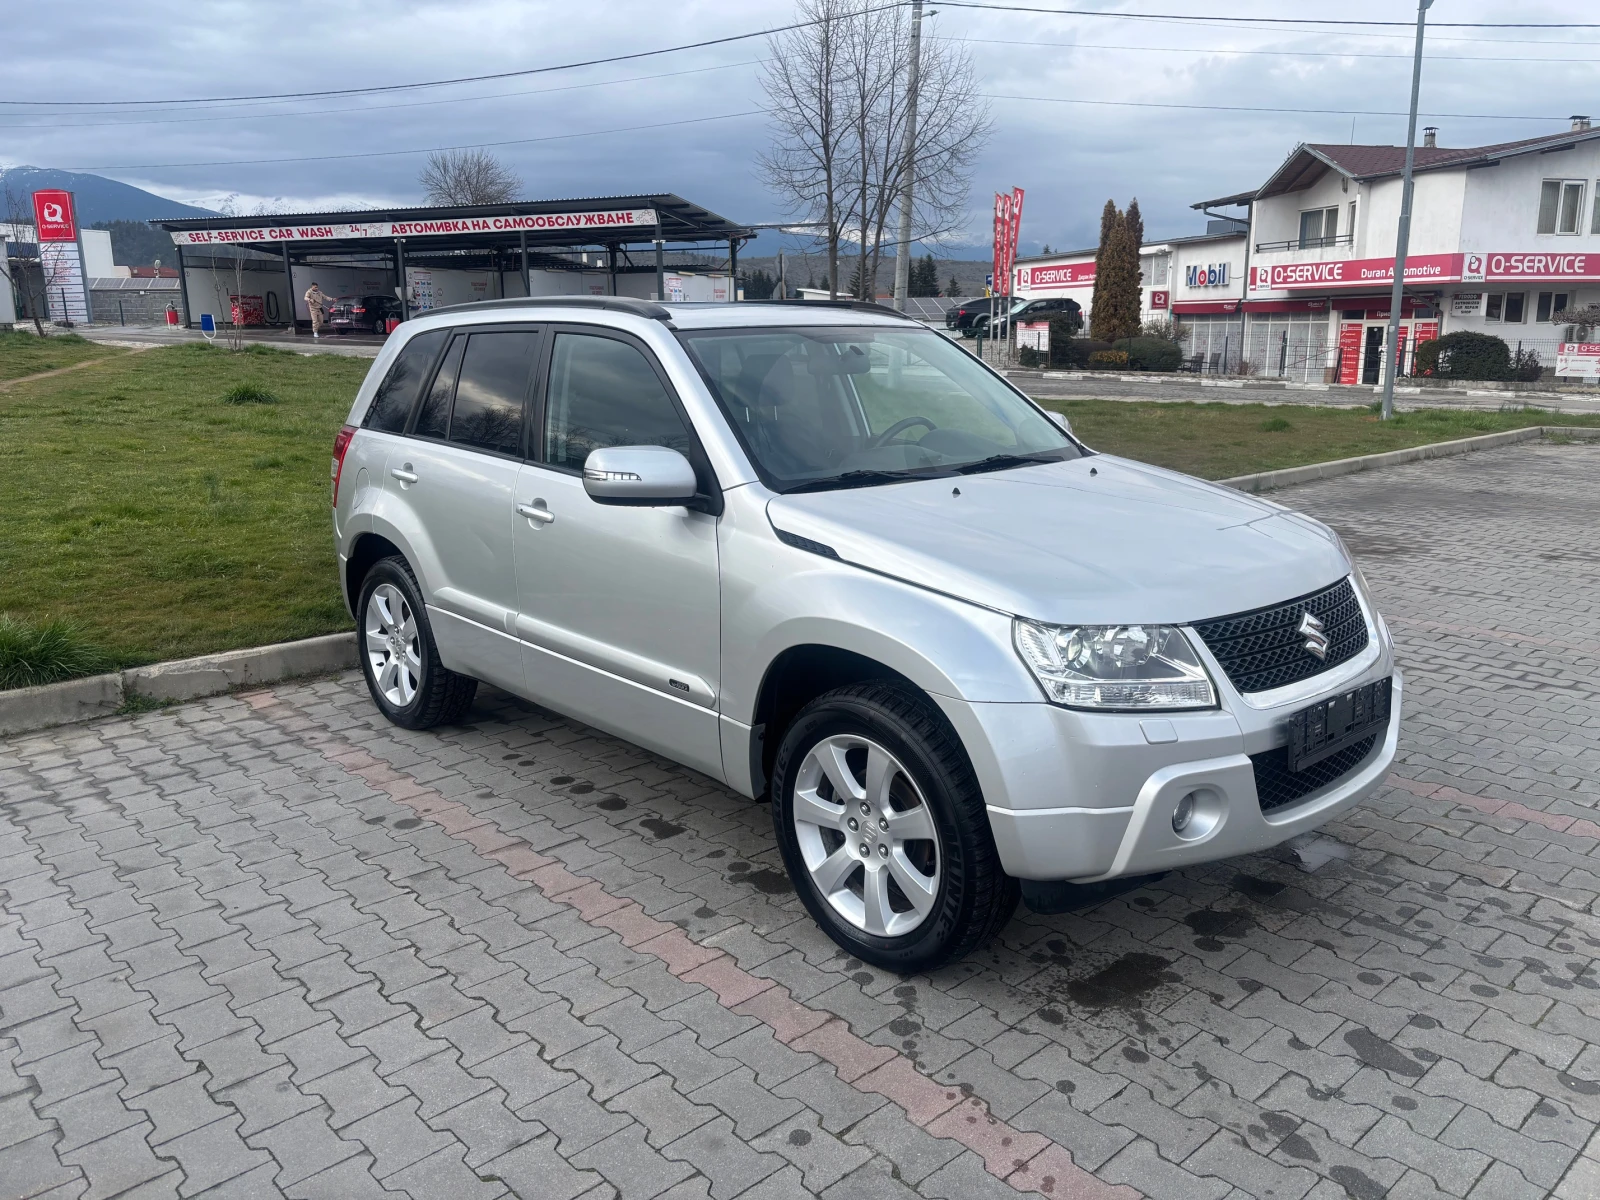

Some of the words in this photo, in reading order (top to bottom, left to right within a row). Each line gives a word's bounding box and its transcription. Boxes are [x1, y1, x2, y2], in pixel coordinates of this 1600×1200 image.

[391, 221, 471, 235] АВТОМИВКА
[471, 219, 491, 230] НА
[492, 212, 634, 231] САМООБСЛУЖВАНЕ
[188, 229, 266, 243] SELF-SERVICE
[268, 227, 294, 240] CAR
[297, 226, 334, 238] WASH
[1274, 263, 1344, 283] Q-SERVICE
[1361, 267, 1386, 279] Duran
[1387, 264, 1441, 277] Aomotive
[1491, 255, 1586, 273] Q-SERVICE
[1034, 268, 1073, 283] Q-SERVICE
[1186, 262, 1227, 286] Mobil
